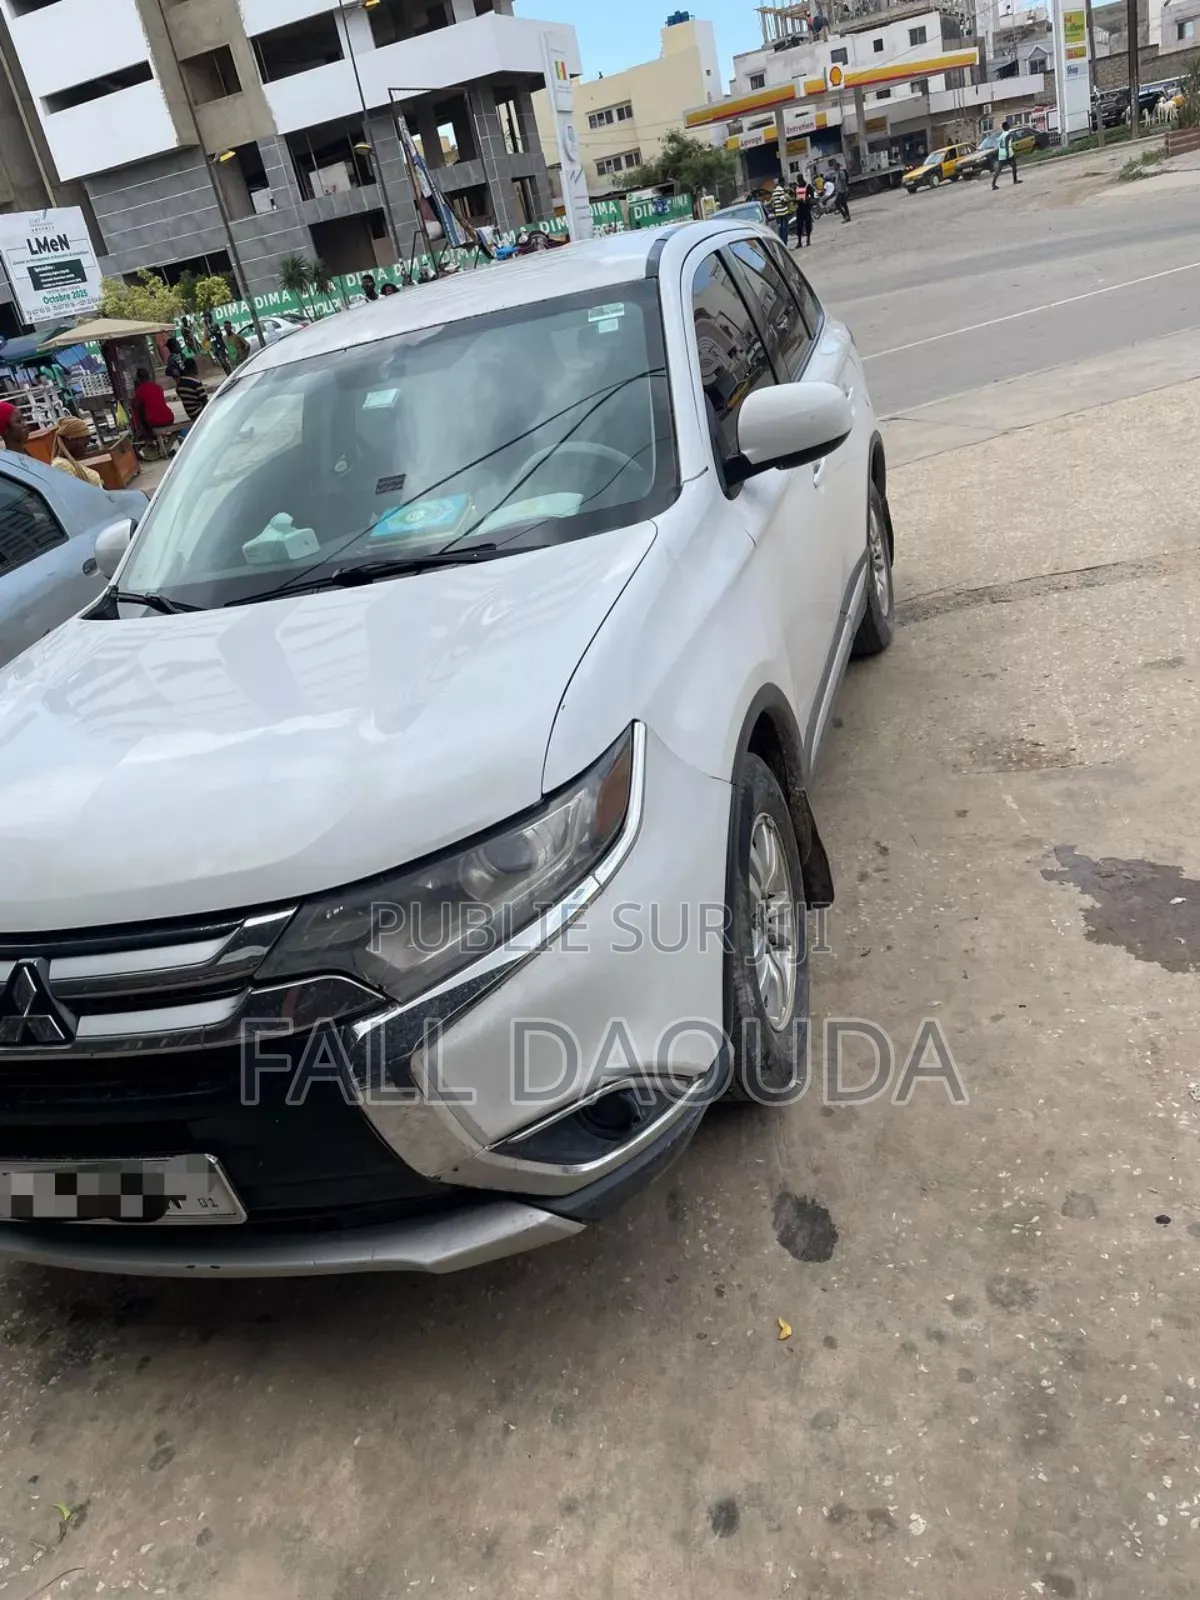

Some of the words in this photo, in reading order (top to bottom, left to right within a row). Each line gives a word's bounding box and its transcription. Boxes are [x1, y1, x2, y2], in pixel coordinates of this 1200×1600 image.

[786, 121, 815, 135] Entretien
[26, 233, 71, 255] LMeN
[254, 290, 292, 310] DIMA
[539, 215, 569, 234] DIM
[42, 293, 71, 305] Octobre
